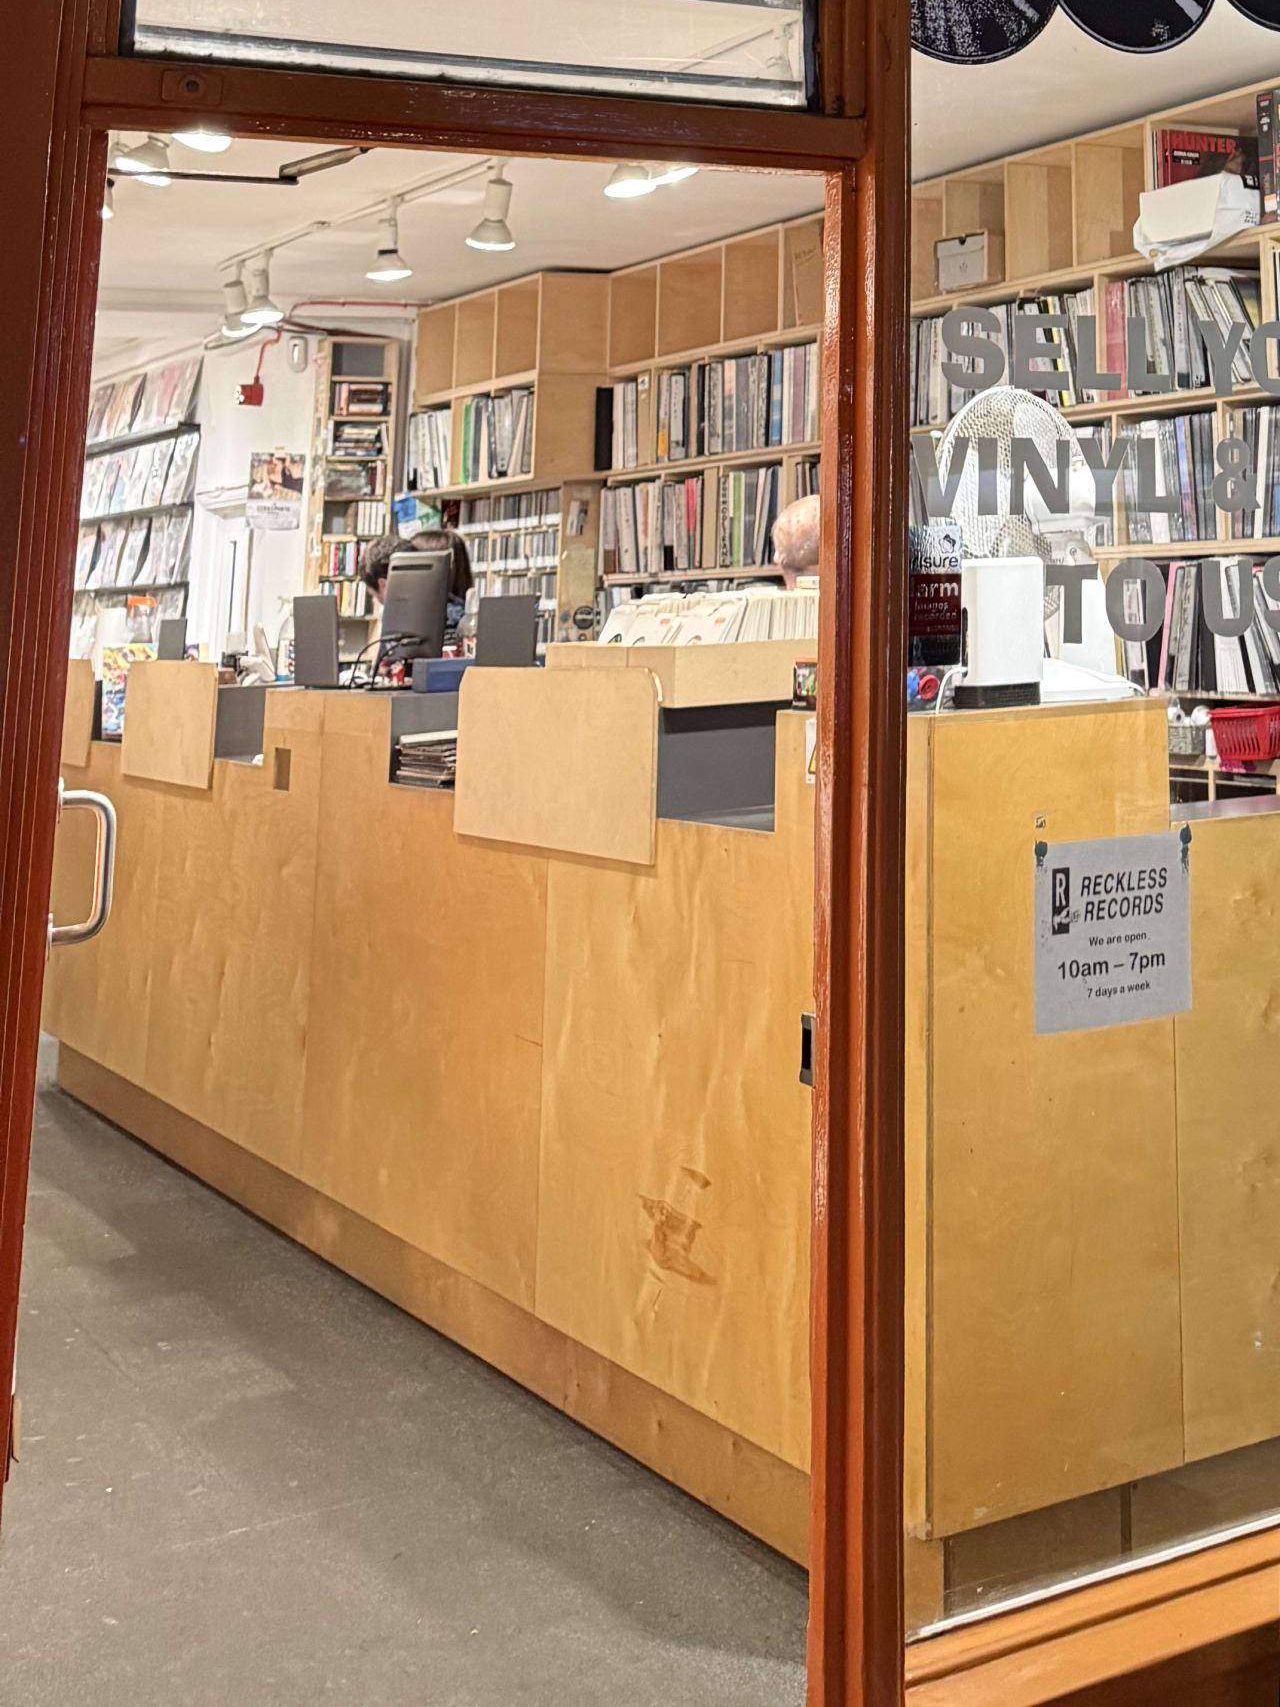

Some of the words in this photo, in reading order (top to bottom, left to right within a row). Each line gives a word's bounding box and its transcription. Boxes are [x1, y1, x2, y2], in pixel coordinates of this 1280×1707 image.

[1170, 135, 1236, 154] HUNTER
[941, 306, 1171, 392] SELL
[911, 433, 1181, 517] VINYL
[1212, 437, 1262, 513] &
[1045, 557, 1167, 644] TO
[1080, 867, 1167, 897] RECKLESS
[1084, 893, 1164, 923] RECORDS
[1089, 935, 1104, 946] We
[1106, 934, 1122, 945] are
[1057, 959, 1109, 980] 10am
[1129, 952, 1166, 975] 7pm
[1087, 987, 1093, 998] 7
[1095, 985, 1118, 998] days
[1119, 985, 1126, 994] a
[1127, 980, 1151, 992] week
